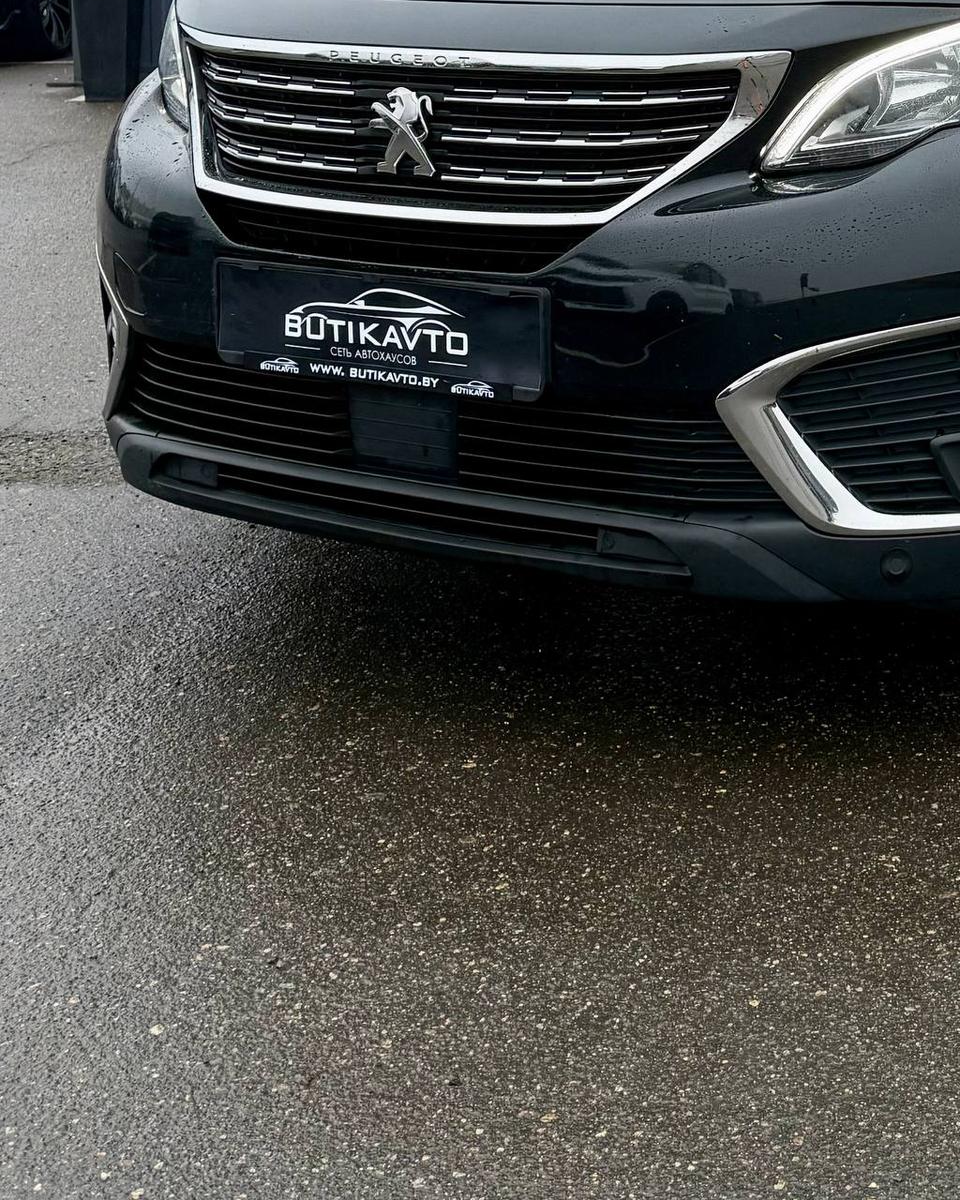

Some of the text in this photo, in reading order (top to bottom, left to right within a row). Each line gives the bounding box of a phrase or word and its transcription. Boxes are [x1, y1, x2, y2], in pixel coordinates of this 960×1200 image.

[329, 50, 471, 68] PEUGEOT
[284, 313, 468, 356] BUTIKAVTO
[330, 346, 417, 366] СЕТЬ АВТОХАУСОВ
[260, 362, 299, 374] BUTIKAVTO
[310, 363, 439, 388] WWW. BUTIKAVTO.BY
[450, 386, 494, 398] BUTIKAVTO
